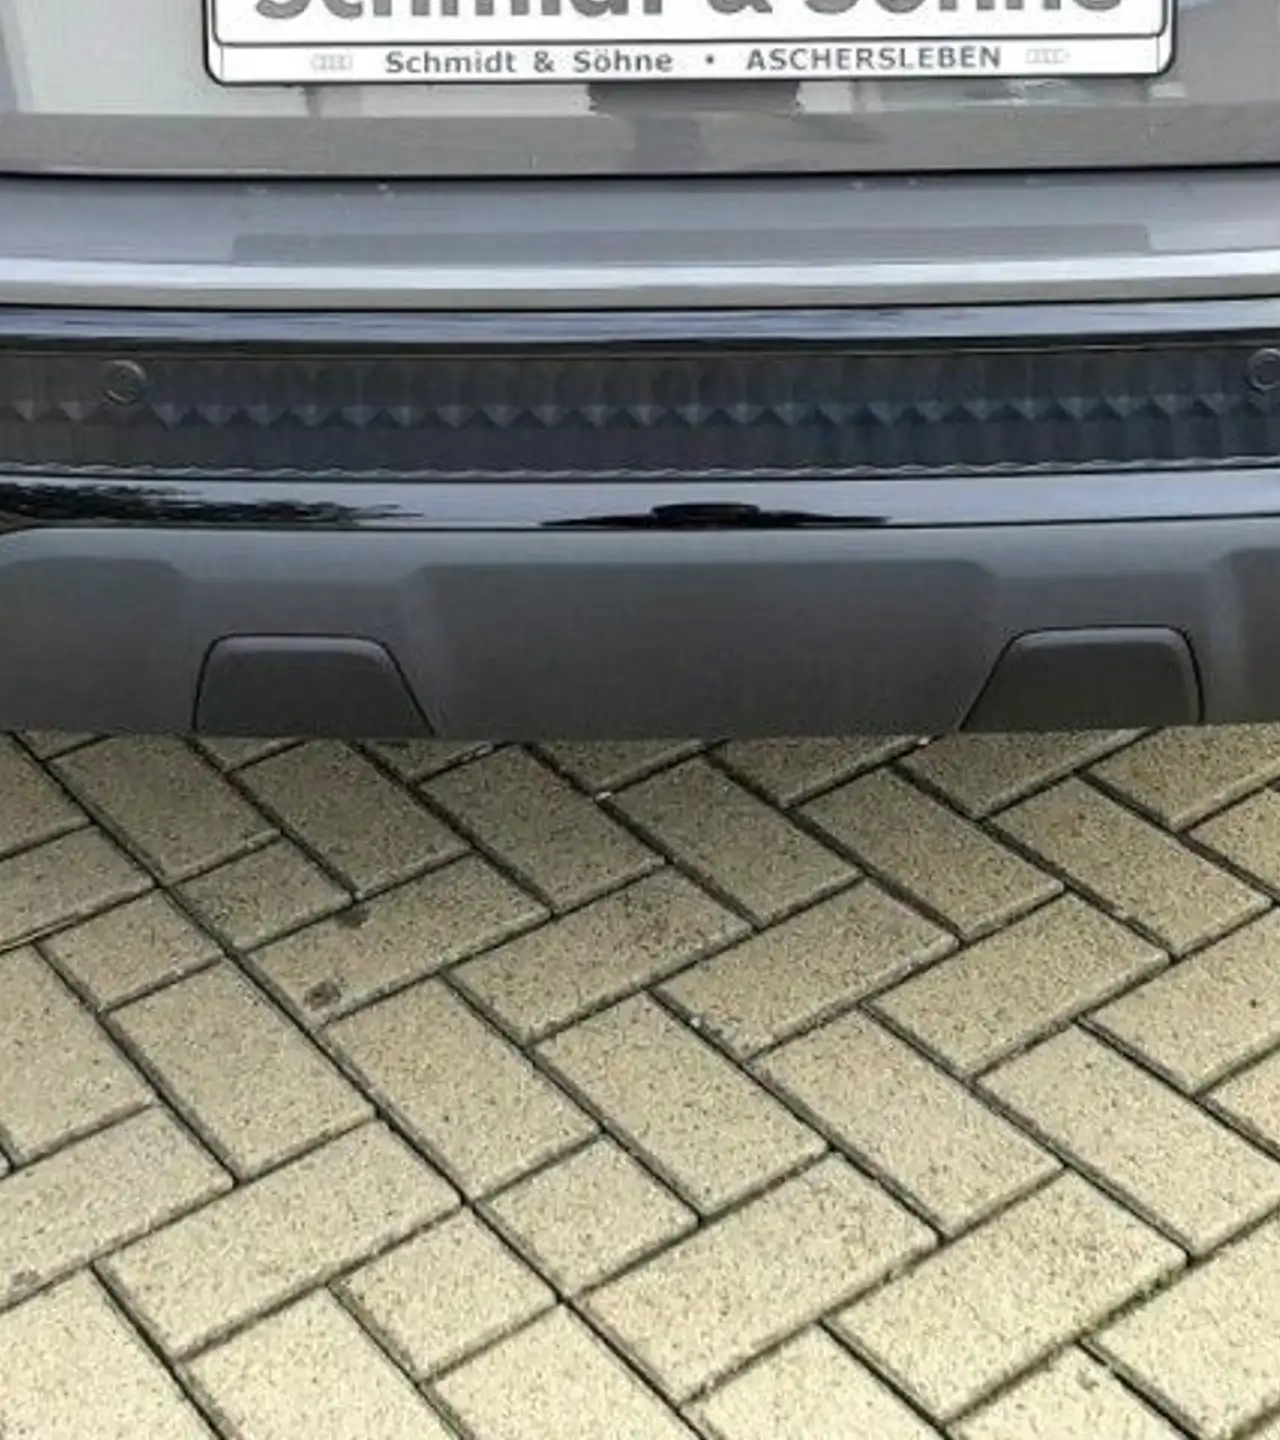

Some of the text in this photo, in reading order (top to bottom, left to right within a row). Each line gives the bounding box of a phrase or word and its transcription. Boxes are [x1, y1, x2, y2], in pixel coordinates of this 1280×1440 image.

[385, 48, 674, 74] Schmidt & Söhne
[745, 45, 1002, 71] ASCHERSLEBEN
